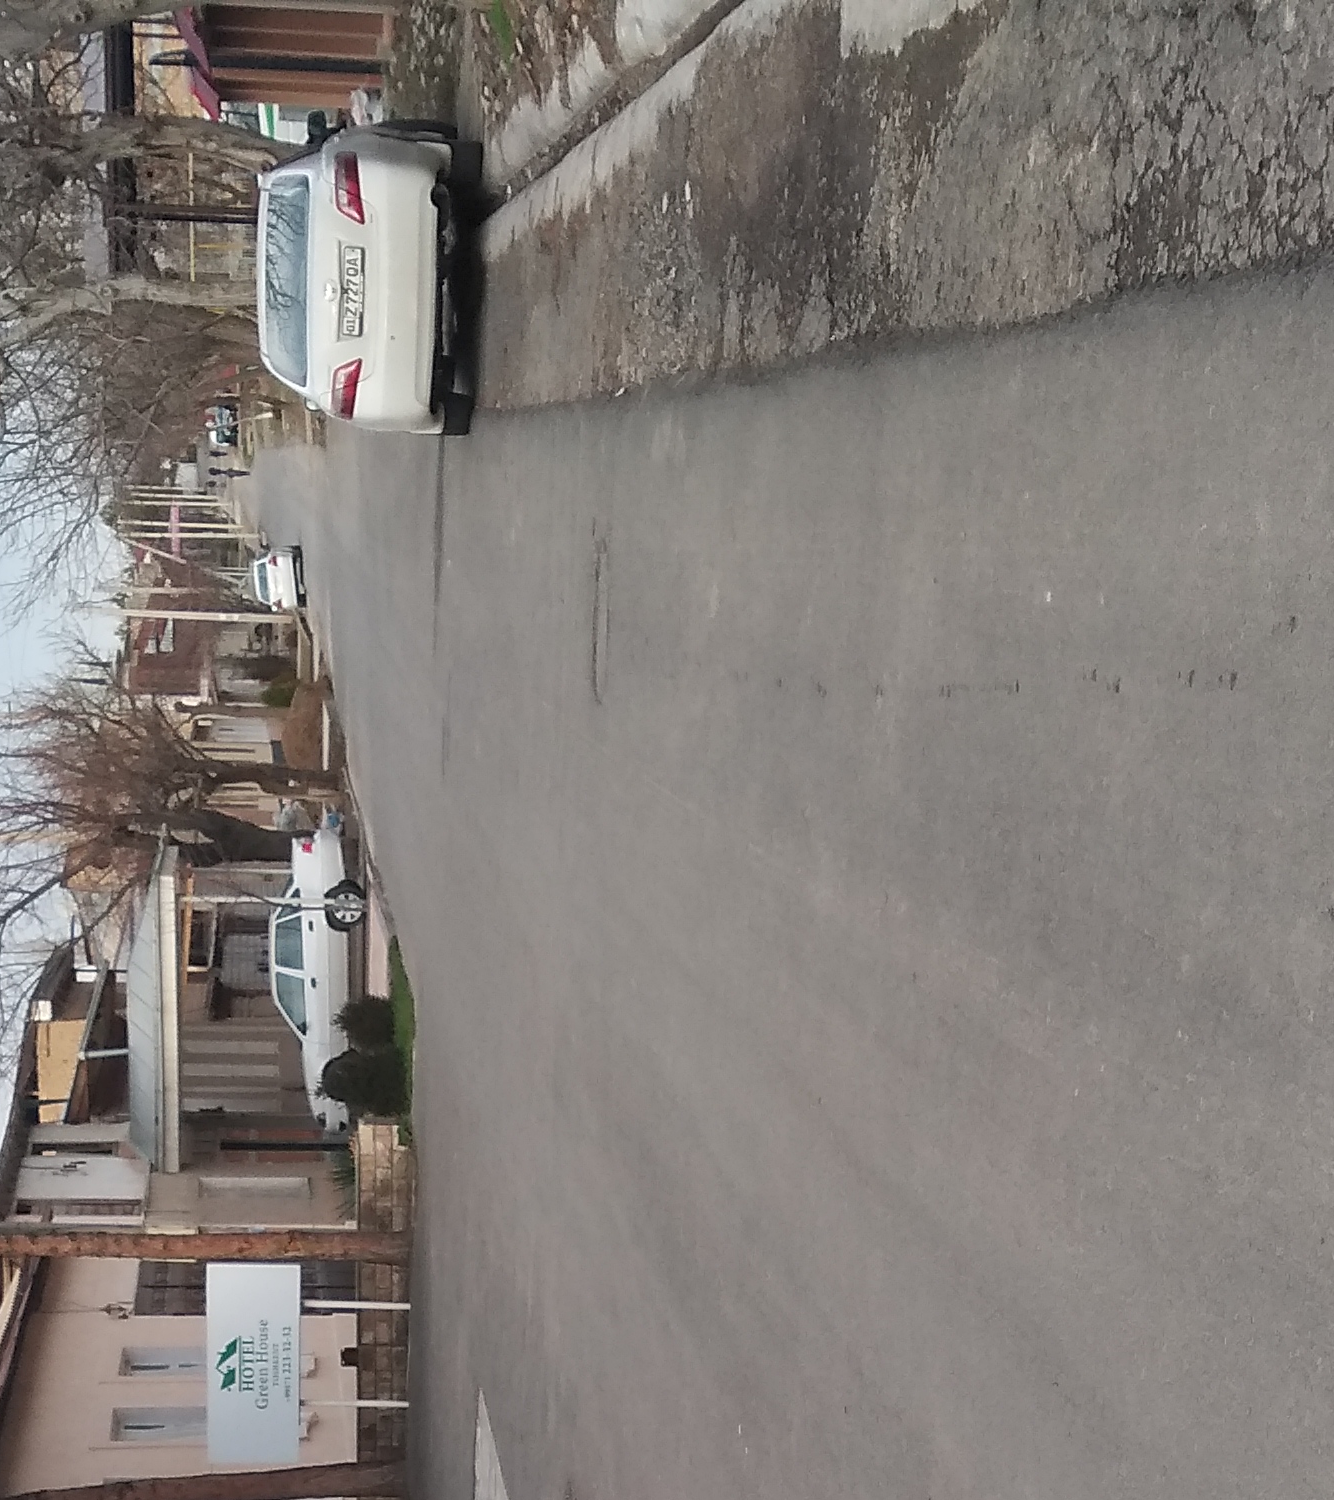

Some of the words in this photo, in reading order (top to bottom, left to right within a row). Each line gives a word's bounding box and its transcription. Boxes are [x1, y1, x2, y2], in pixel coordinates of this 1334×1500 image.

[255, 1318, 268, 1361] House
[242, 1335, 254, 1390] HOTEL
[255, 1366, 268, 1409] Green
